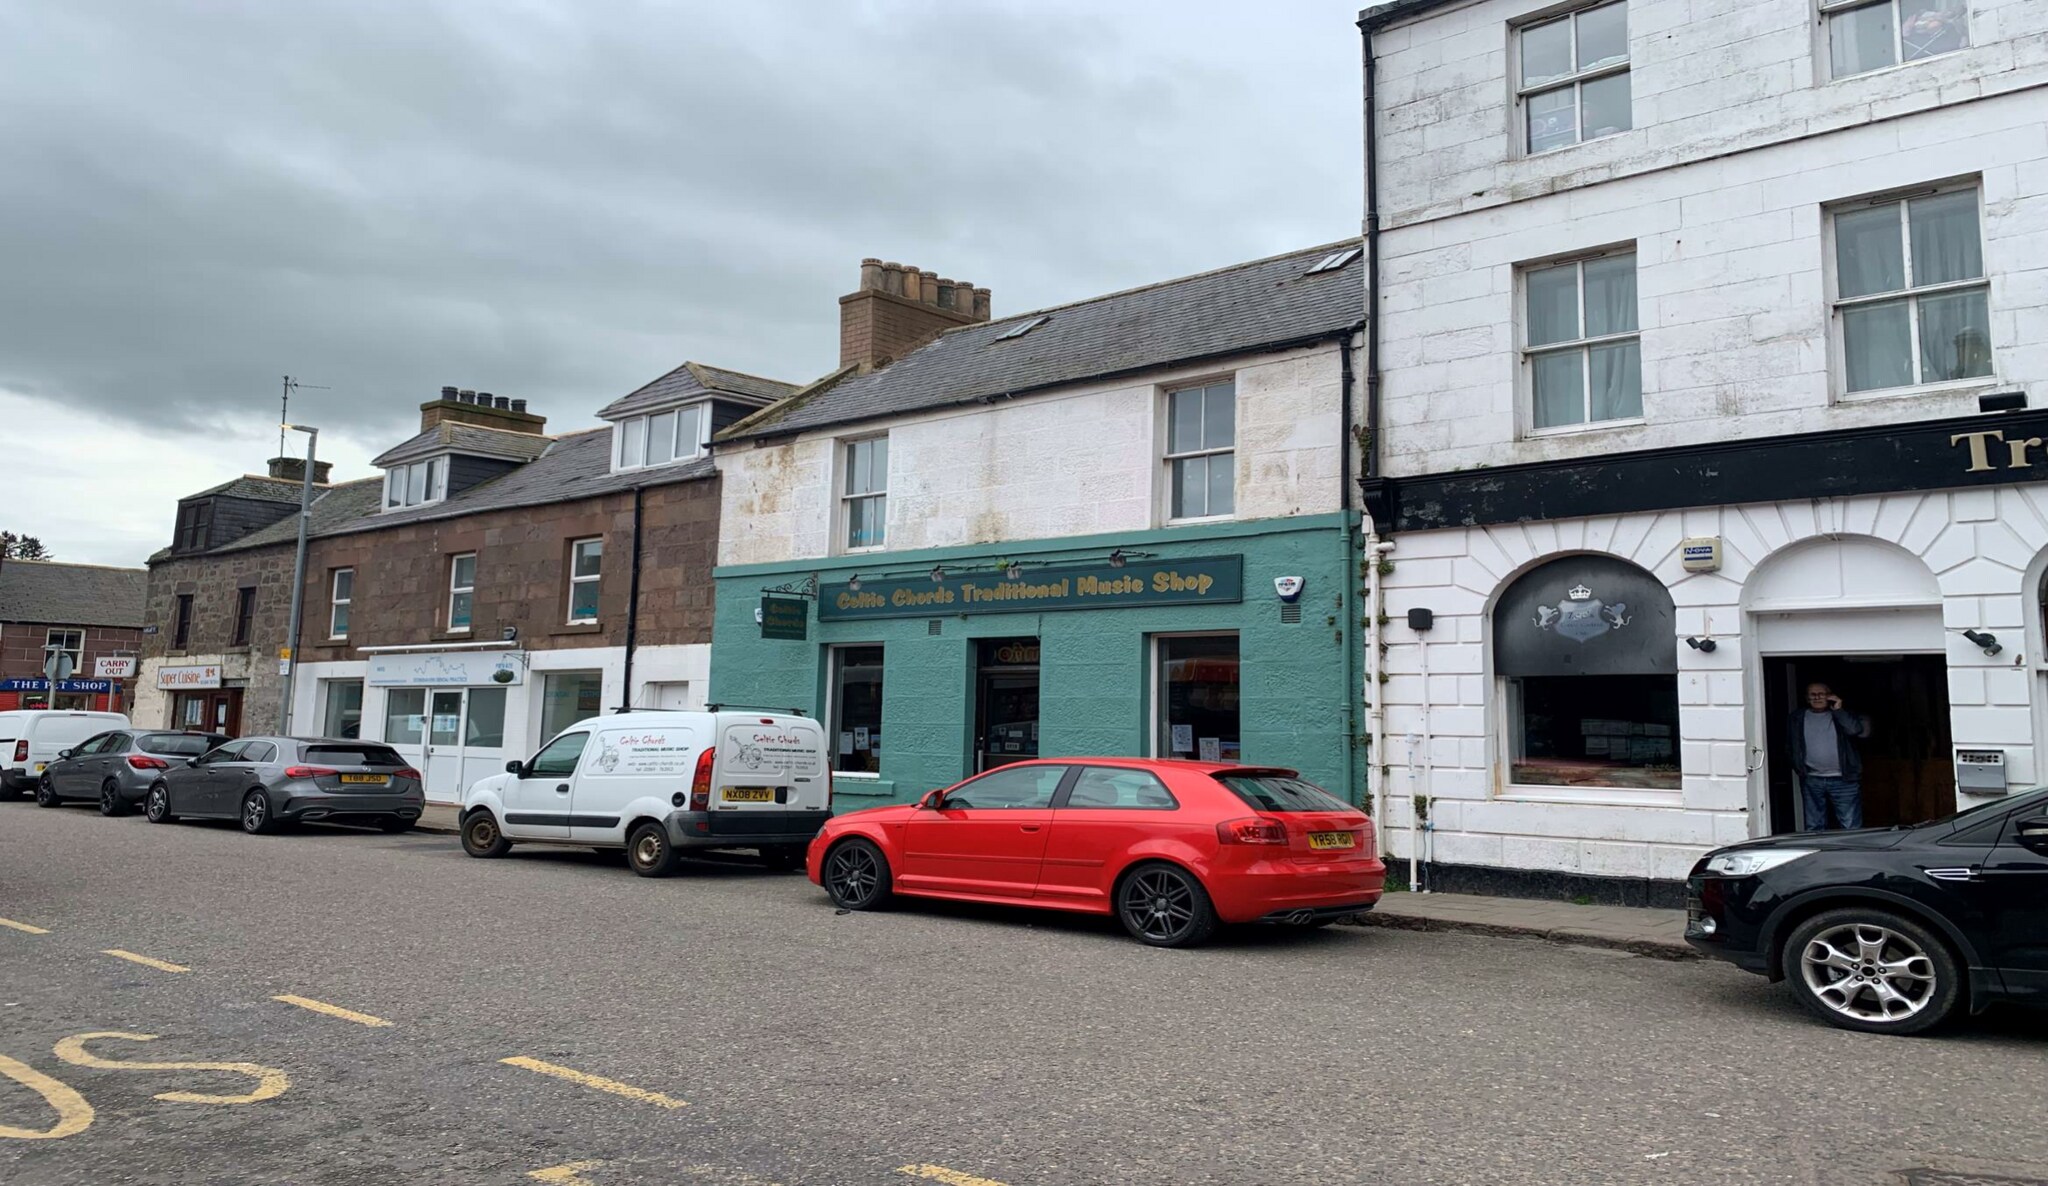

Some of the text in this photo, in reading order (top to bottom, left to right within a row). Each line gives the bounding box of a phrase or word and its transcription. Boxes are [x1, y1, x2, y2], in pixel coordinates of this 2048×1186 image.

[1951, 430, 2048, 472] Tr
[837, 571, 1214, 609] Celtic Chords Traditional Music Shop
[12, 681, 39, 689] THE
[73, 681, 107, 690] SHOP
[753, 734, 775, 743] Celtic
[726, 790, 770, 799] NX08 ZVV
